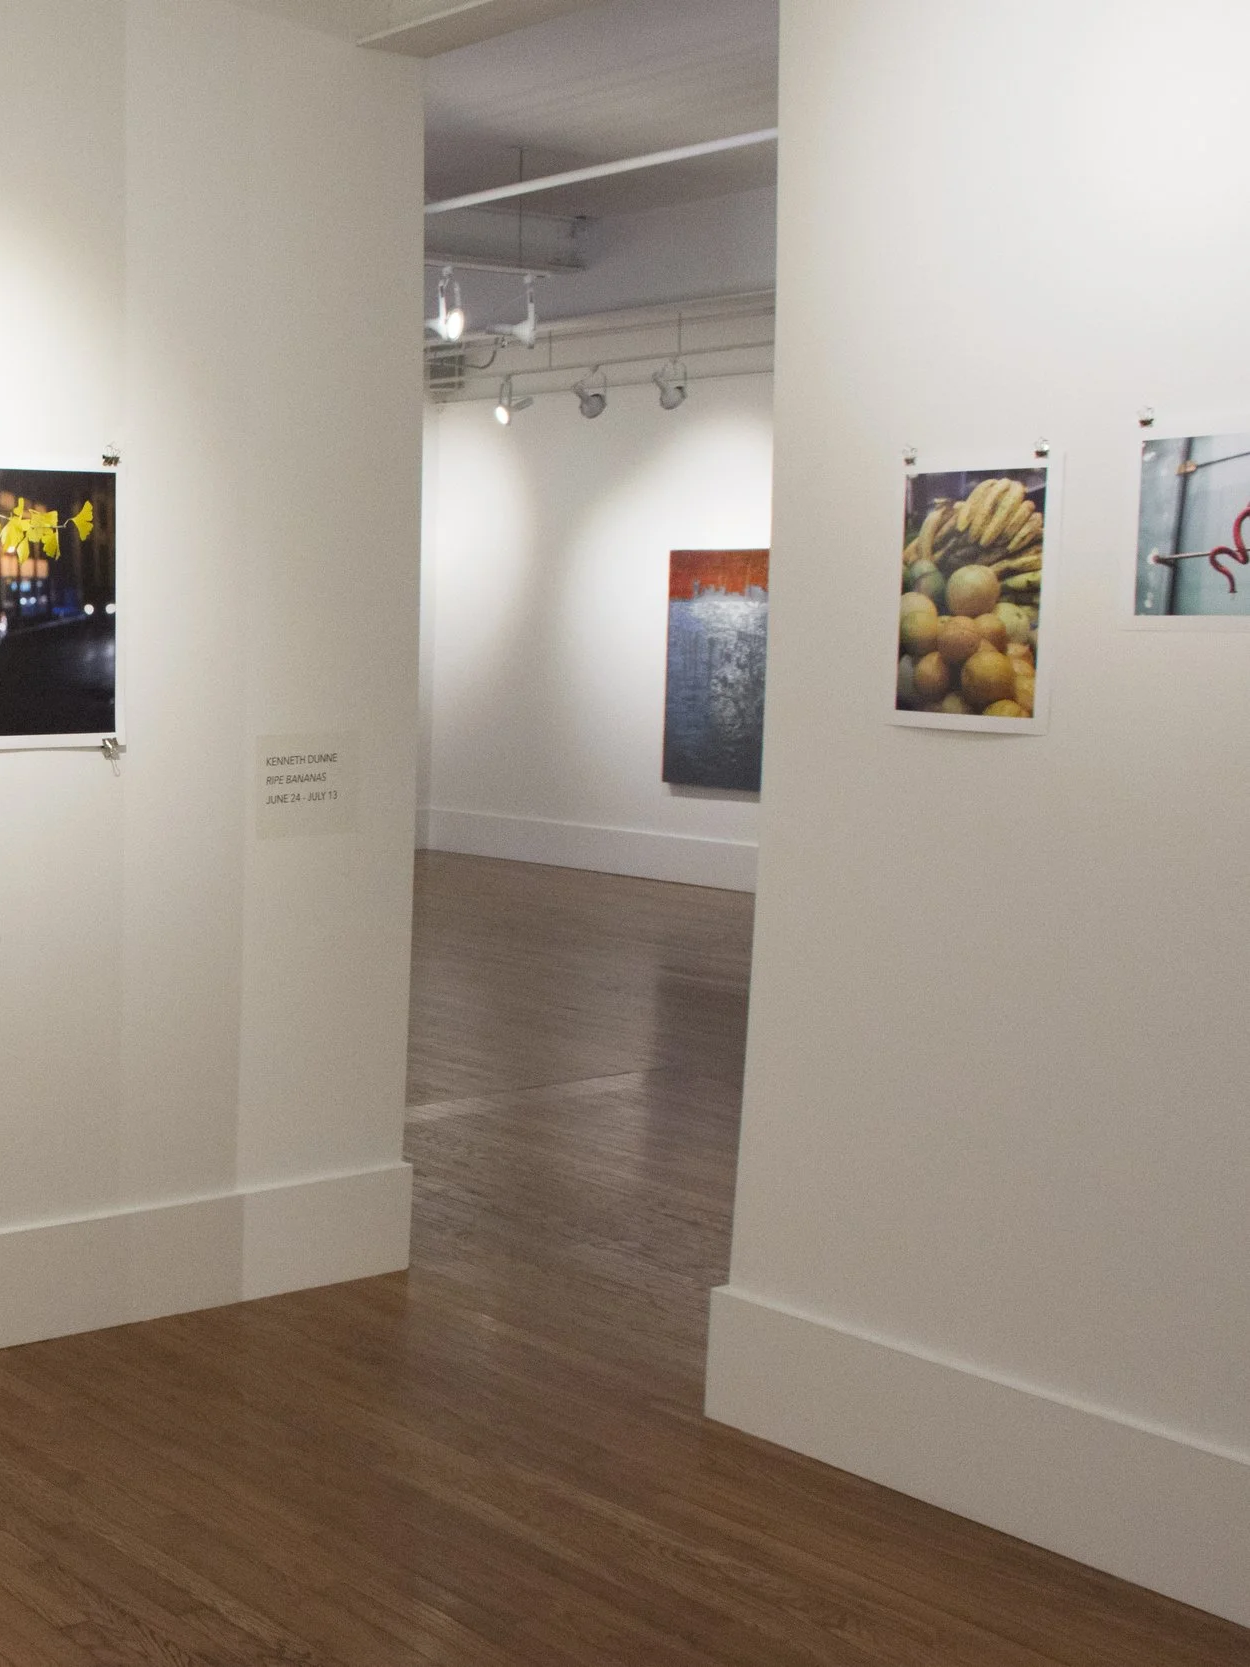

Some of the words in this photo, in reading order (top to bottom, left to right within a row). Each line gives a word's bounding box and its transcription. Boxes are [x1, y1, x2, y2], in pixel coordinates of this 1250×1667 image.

[266, 755, 306, 767] KENNETH
[308, 753, 338, 764] DUNNE
[266, 775, 284, 785] RIPE
[286, 772, 327, 784] BANANAS
[266, 794, 288, 805] JUNE
[291, 793, 301, 803] 24
[308, 791, 326, 802] JULY
[328, 790, 338, 800] 13
